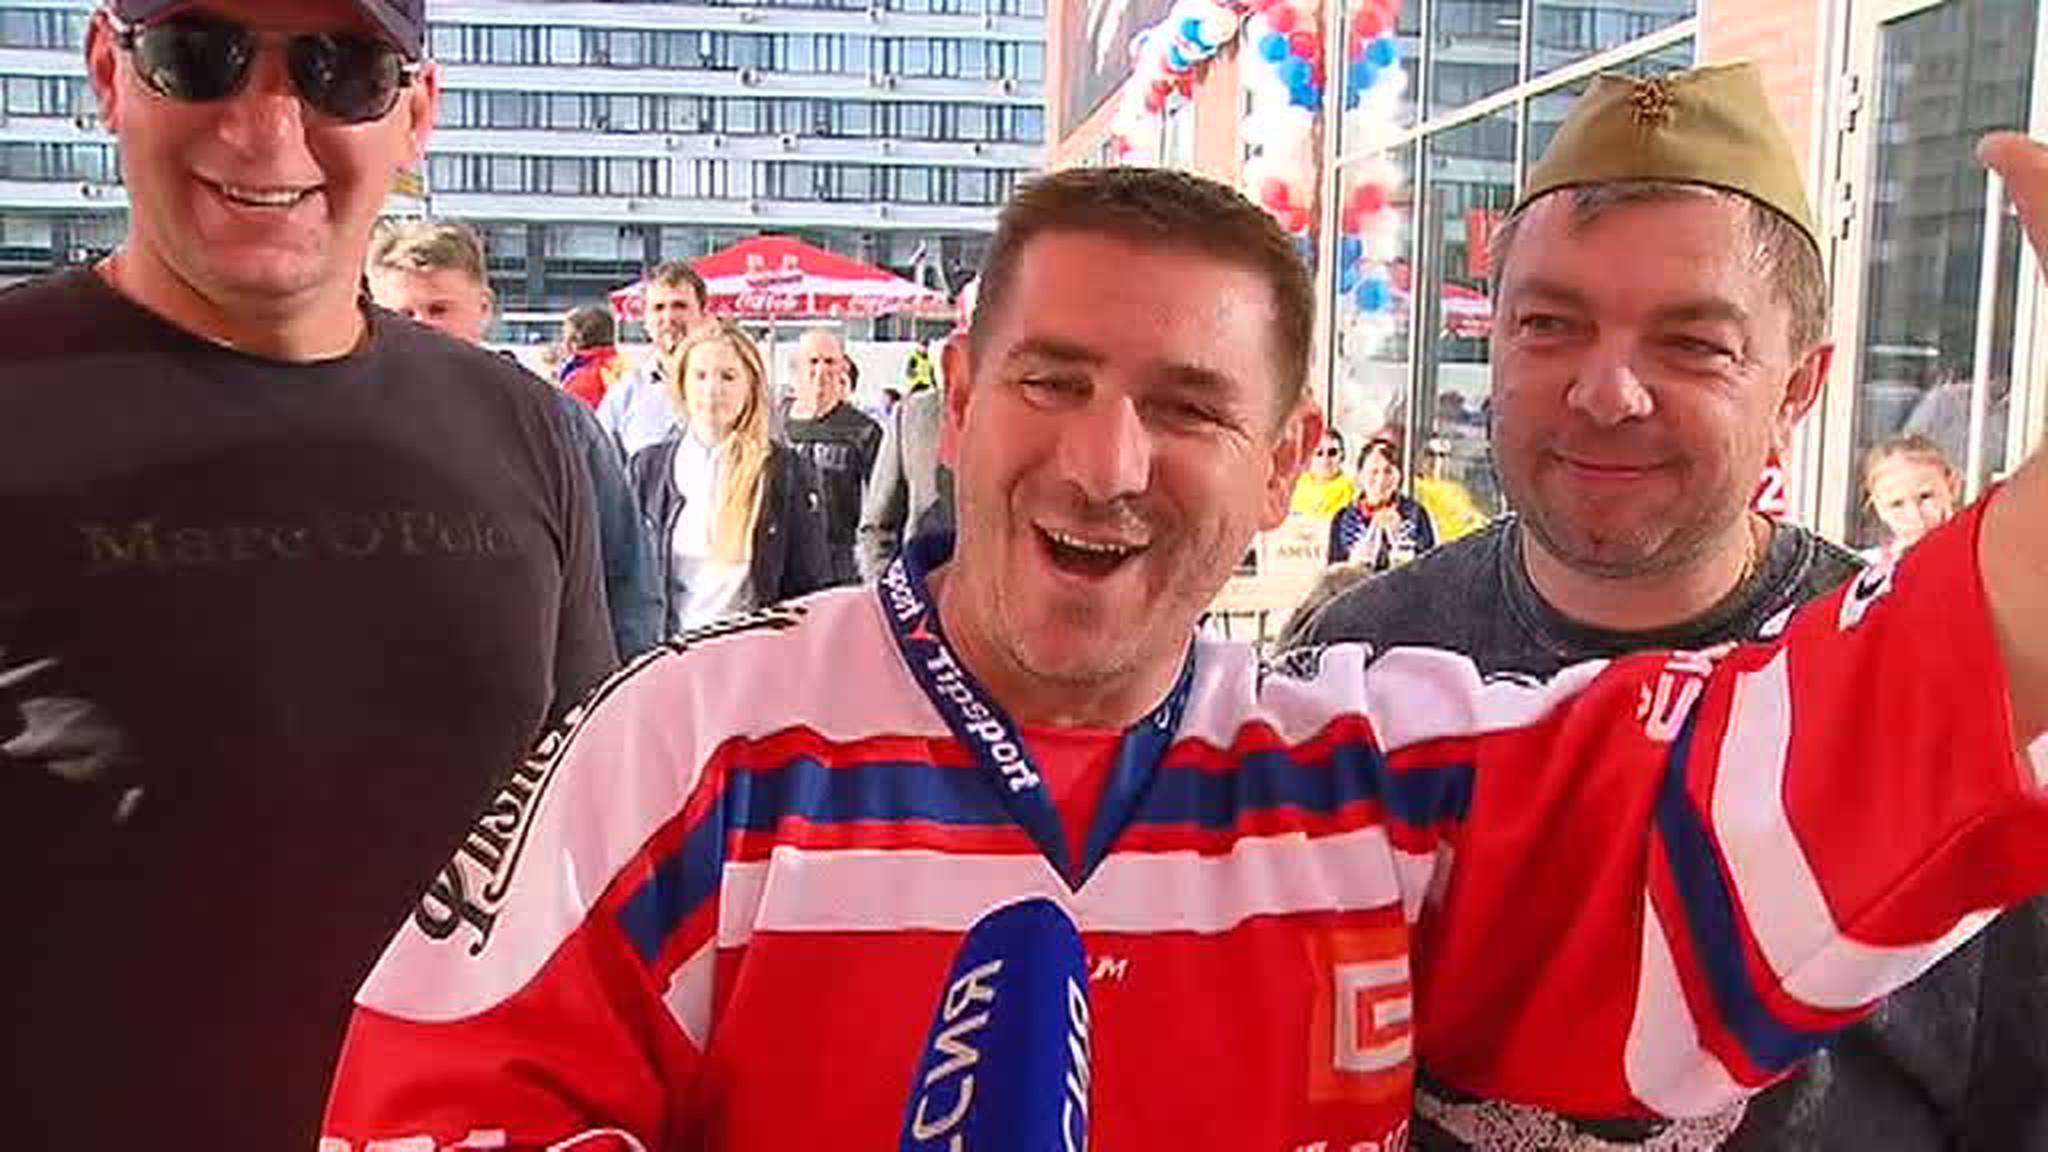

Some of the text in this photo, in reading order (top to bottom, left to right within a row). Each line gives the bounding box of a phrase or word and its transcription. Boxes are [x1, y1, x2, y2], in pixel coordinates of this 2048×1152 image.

[78, 515, 308, 563] Marc
[926, 644, 1040, 792] Tipsport
[912, 959, 1004, 1152] СИЯ
